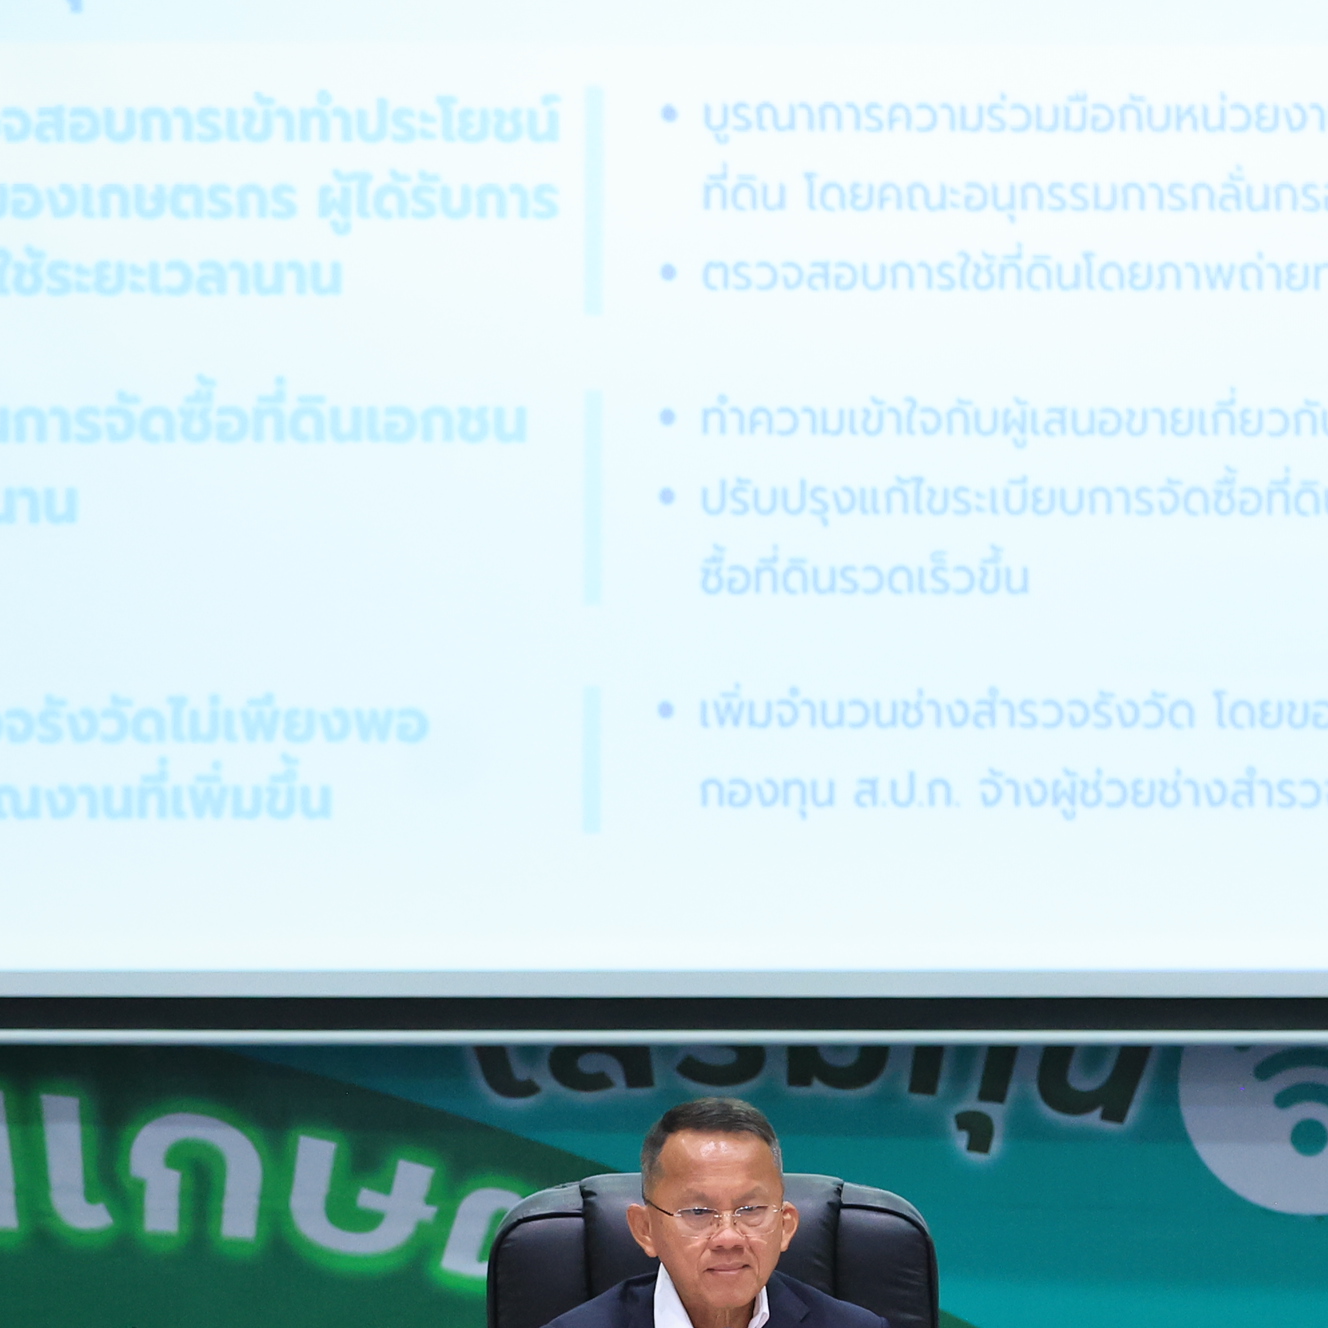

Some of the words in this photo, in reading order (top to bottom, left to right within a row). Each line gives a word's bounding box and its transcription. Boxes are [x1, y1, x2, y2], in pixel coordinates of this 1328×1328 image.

[316, 167, 561, 238] ผู้ได้รับการ
[701, 160, 788, 213] ที่ดิน
[698, 542, 1031, 597] ซื้อที่ดินรวดเร็วขึ้น
[698, 681, 1197, 732] เพิ่มจำนวนช่างสำรวจรังวัด
[698, 772, 837, 822] กองทุน
[852, 769, 960, 810] ส.ป.ก.
